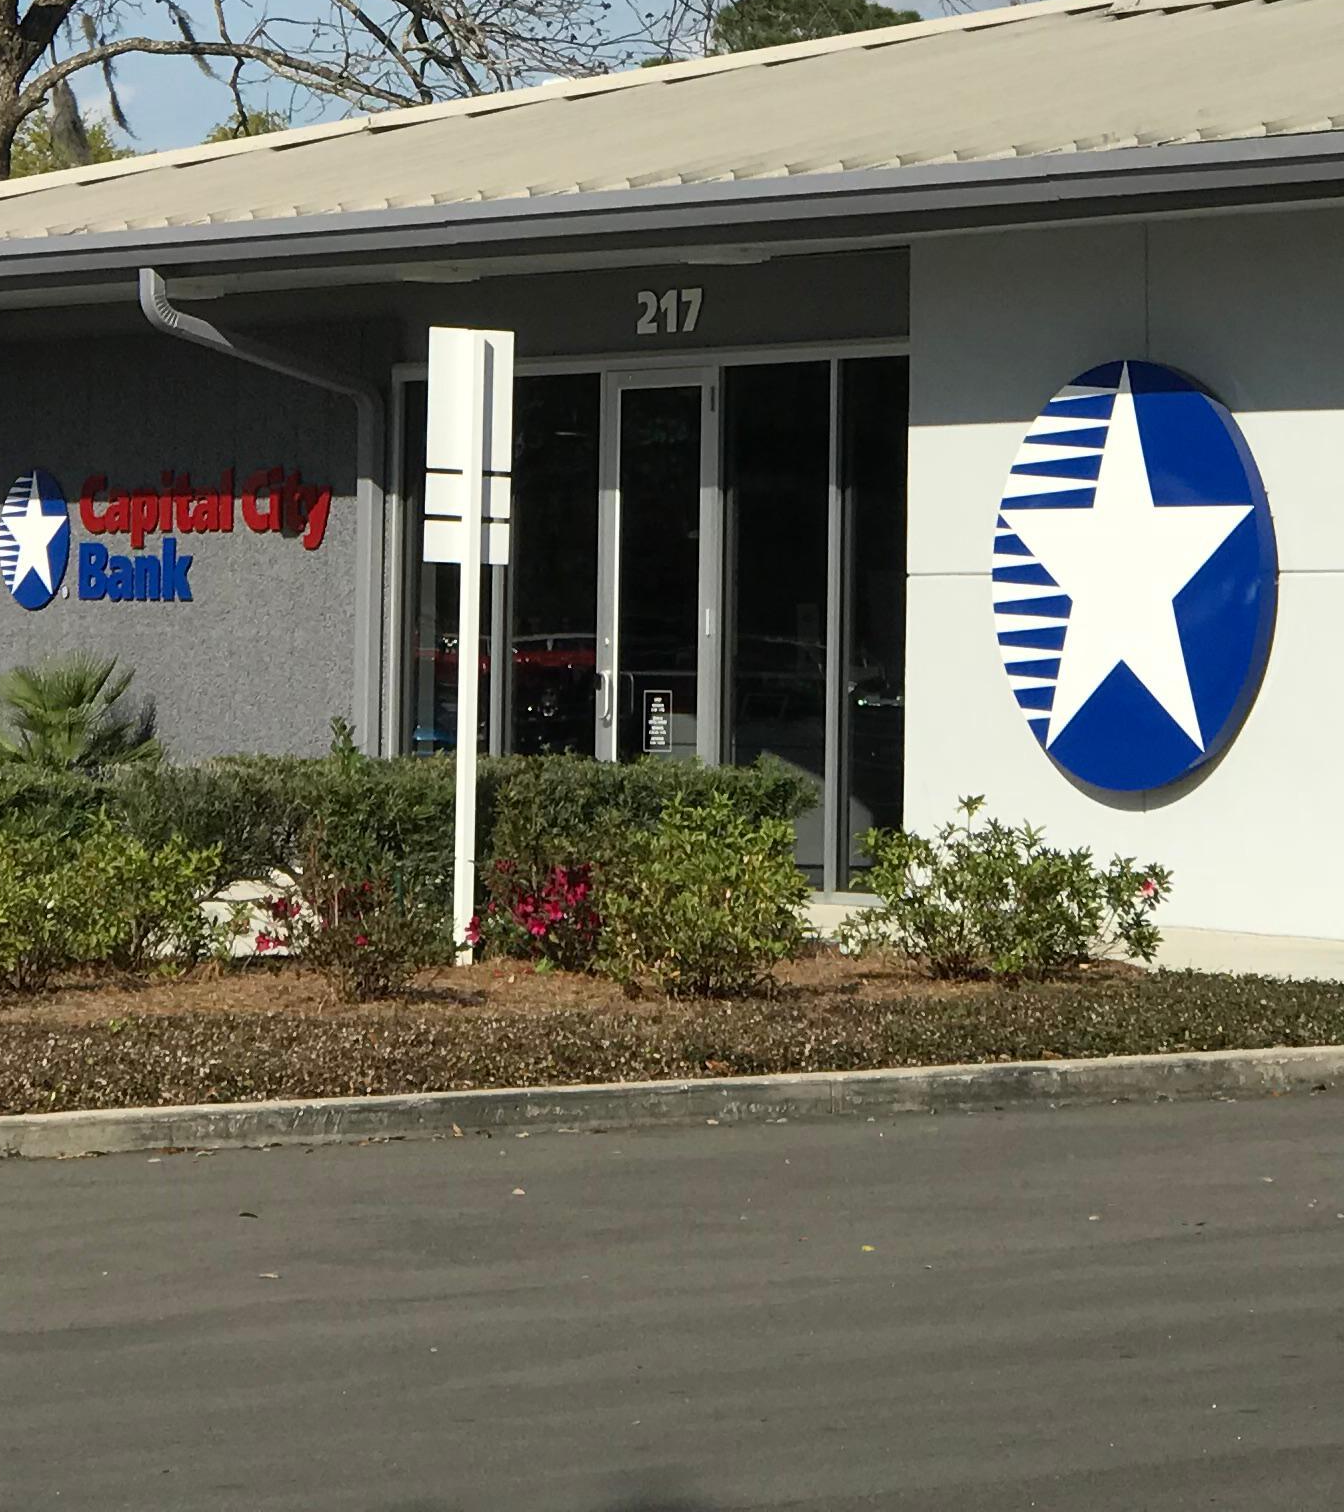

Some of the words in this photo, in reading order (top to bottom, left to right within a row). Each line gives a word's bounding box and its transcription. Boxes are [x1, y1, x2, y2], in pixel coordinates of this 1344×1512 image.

[636, 287, 703, 335] 217
[78, 466, 236, 550] Capital
[241, 466, 332, 551] City
[78, 537, 193, 602] Bank
